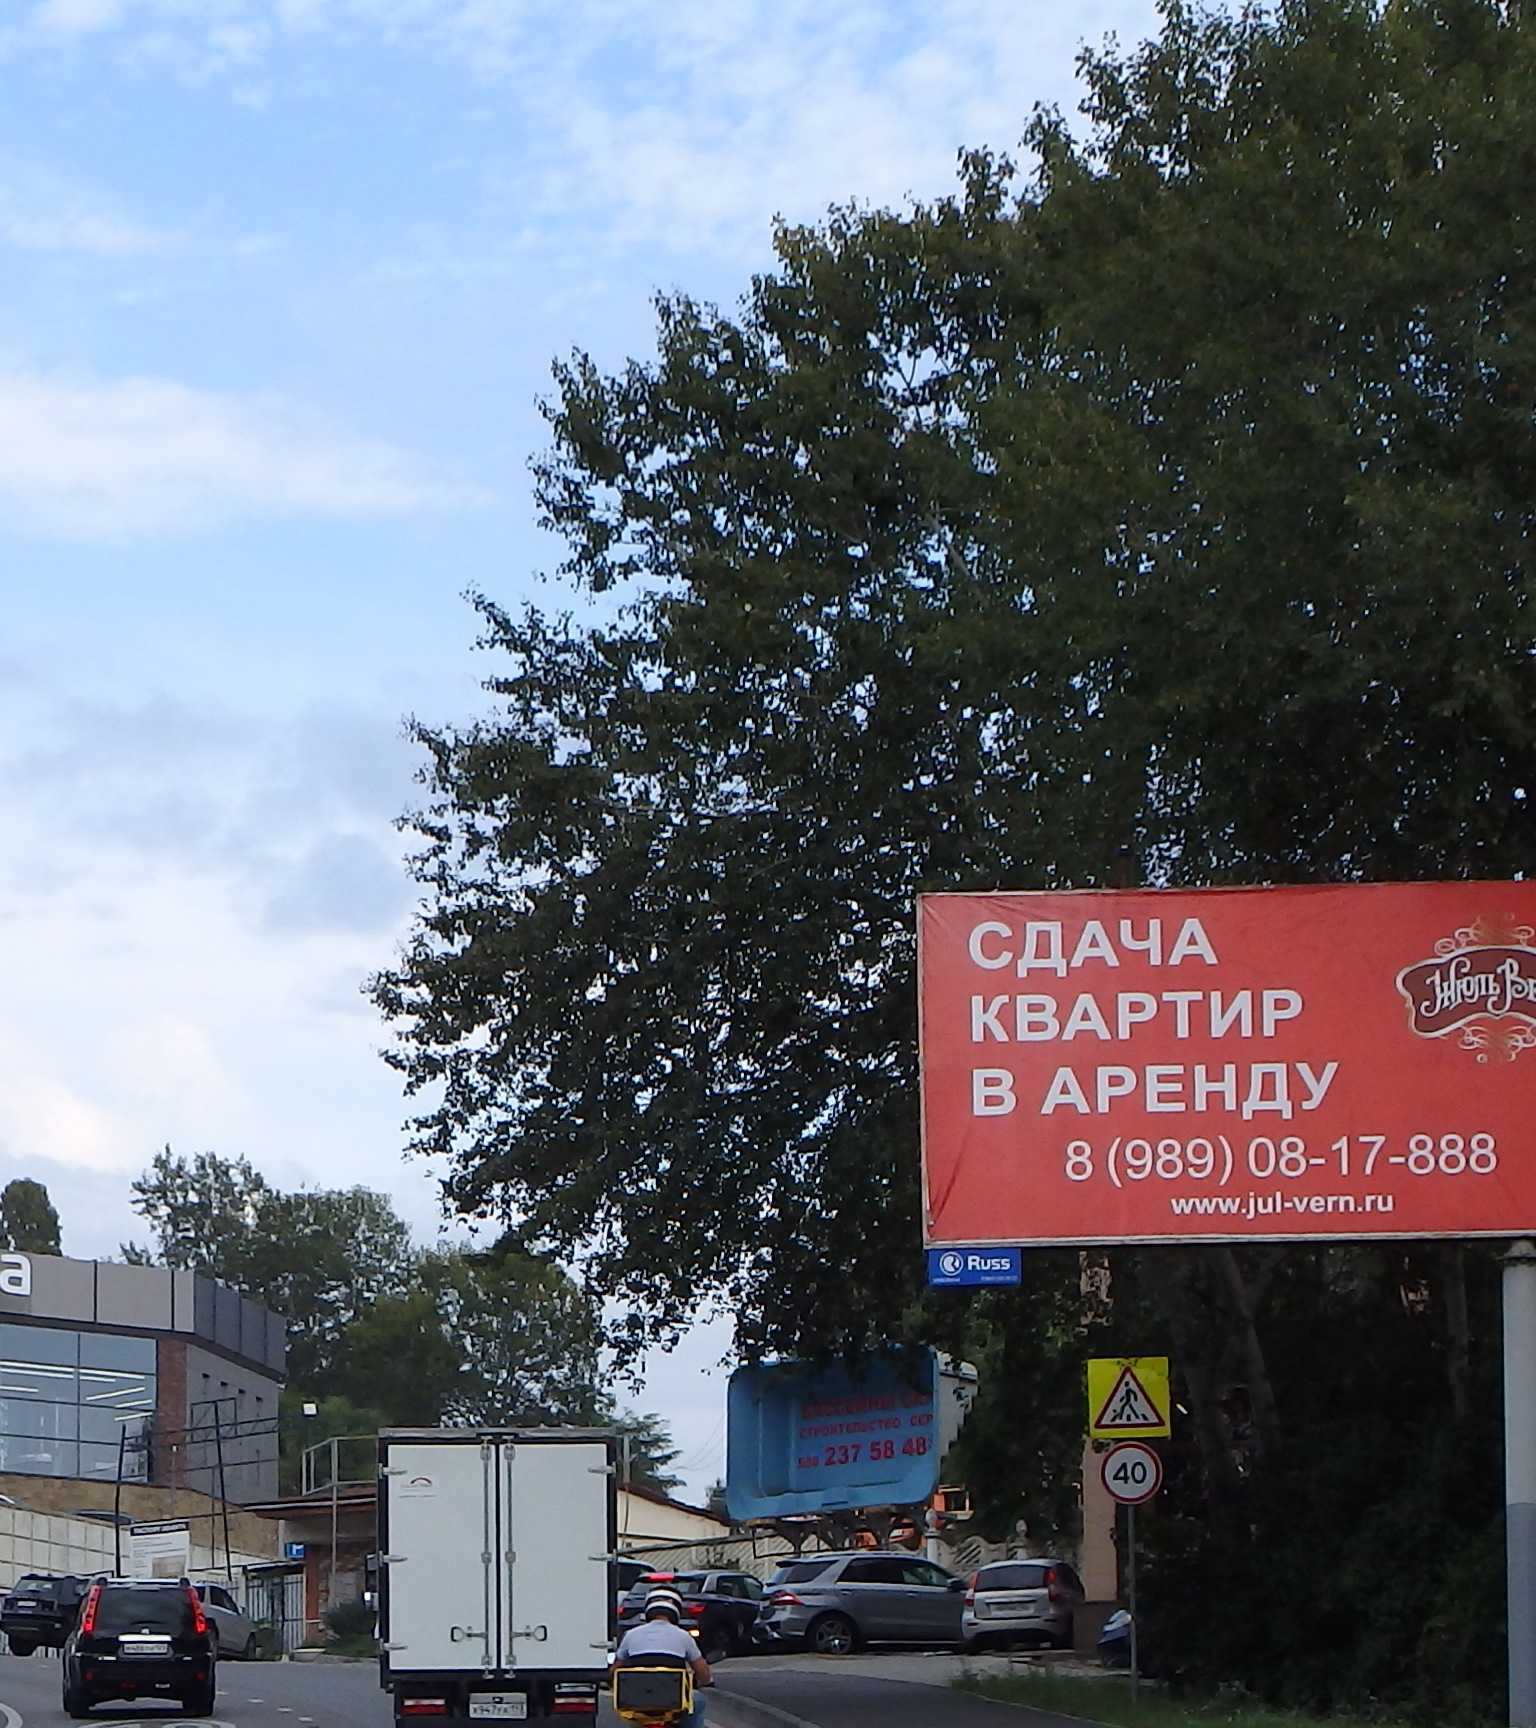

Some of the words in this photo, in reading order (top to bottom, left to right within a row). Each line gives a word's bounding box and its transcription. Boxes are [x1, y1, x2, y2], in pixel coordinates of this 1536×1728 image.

[968, 918, 1218, 979] СДАЧА
[971, 989, 1303, 1043] КВАРТИР
[972, 1068, 1017, 1116] В
[1040, 1062, 1339, 1120] АРЕНДУ
[1065, 1140, 1093, 1181] 8
[1107, 1135, 1233, 1188] (989)
[1248, 1133, 1497, 1178] 08-17-888
[1170, 1191, 1393, 1220] www.jul-vern.ru
[967, 1255, 1011, 1271] Russ
[824, 1444, 863, 1466] 237
[869, 1439, 895, 1461] 58
[1113, 1461, 1147, 1484] 40
